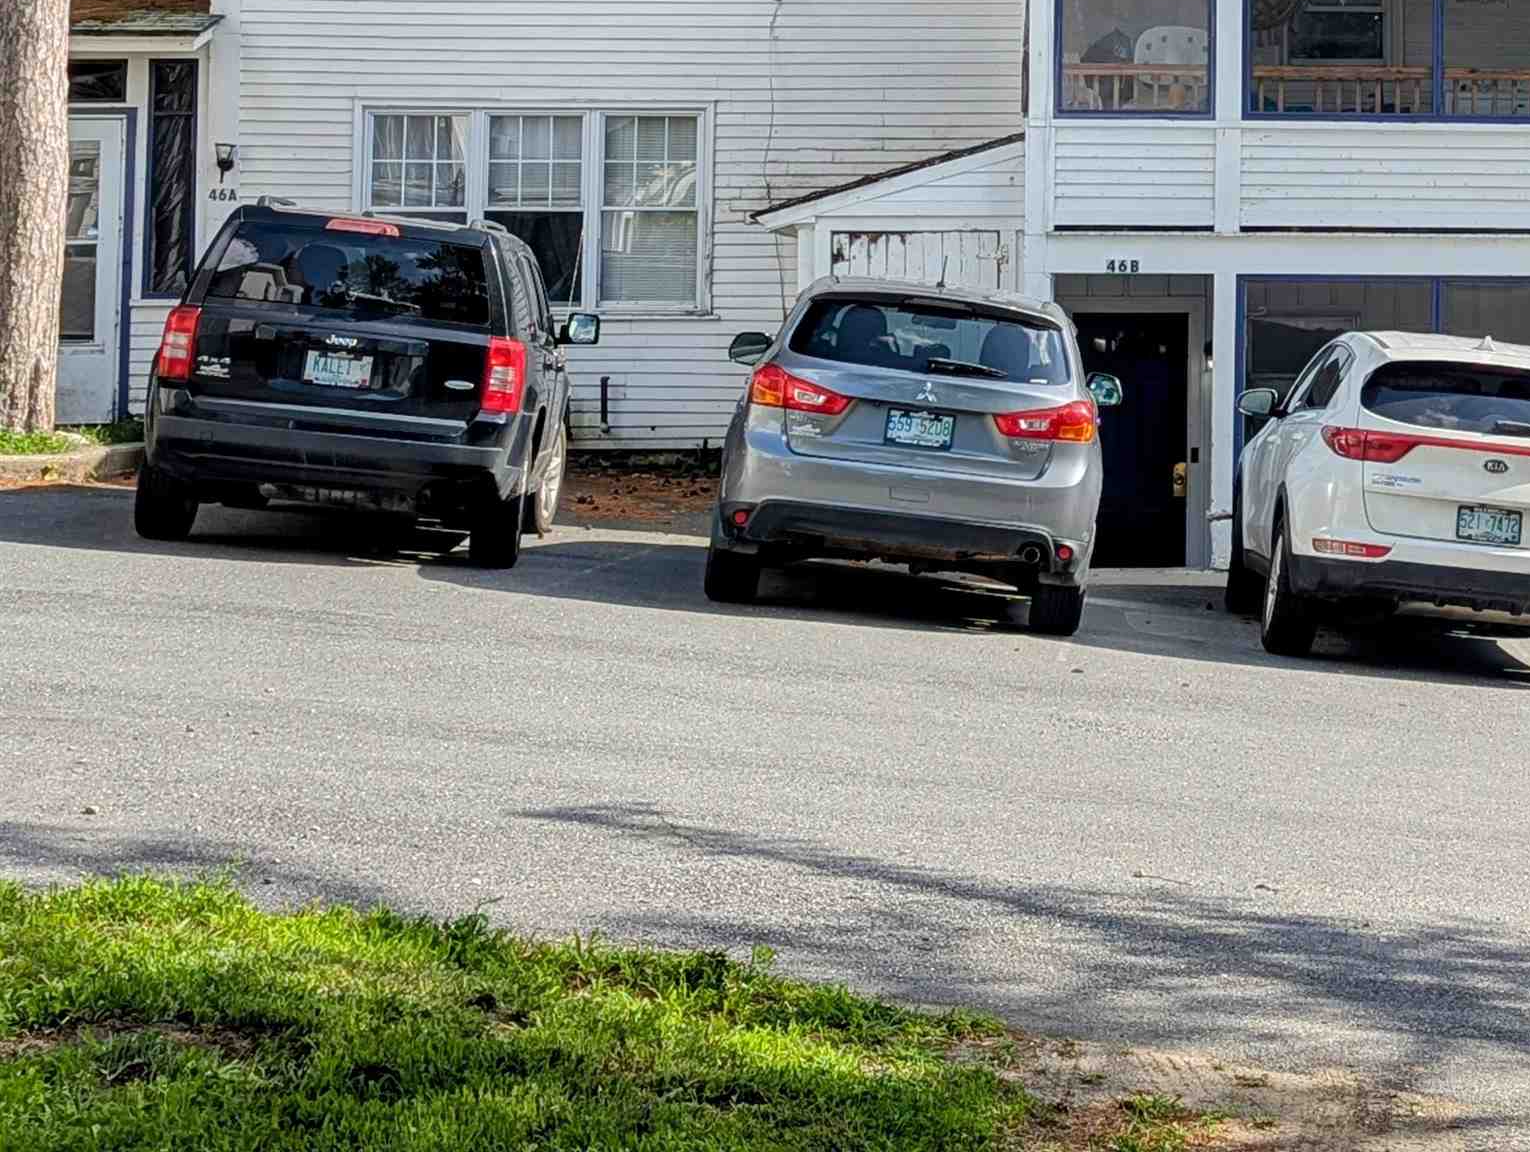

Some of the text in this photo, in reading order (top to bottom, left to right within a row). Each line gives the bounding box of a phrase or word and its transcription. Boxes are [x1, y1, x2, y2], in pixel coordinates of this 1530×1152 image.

[208, 188, 238, 201] 46A
[1106, 259, 1140, 273] 46B
[325, 334, 358, 348] Jeep
[1459, 512, 1481, 530] 521
